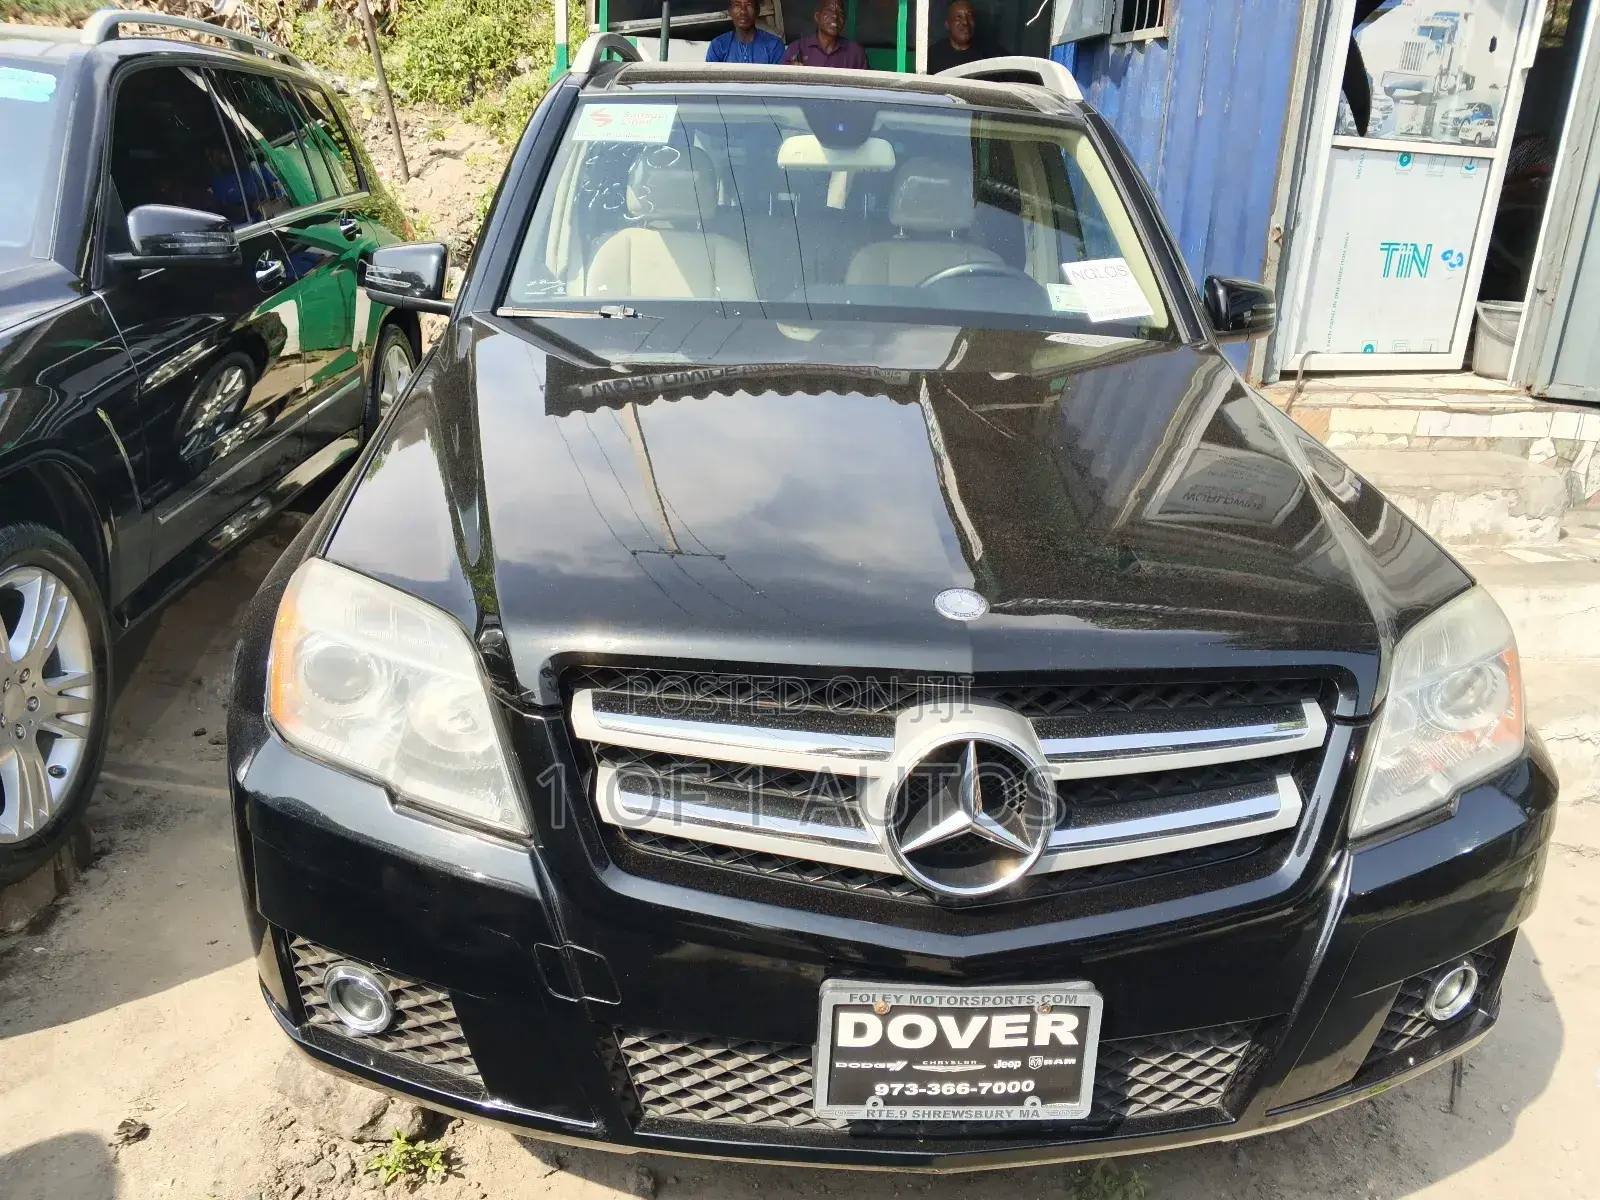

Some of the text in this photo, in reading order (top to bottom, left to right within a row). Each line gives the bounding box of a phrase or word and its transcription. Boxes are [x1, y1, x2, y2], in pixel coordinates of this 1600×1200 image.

[849, 993, 1079, 1006] FOLEY MOTORSPORTS.COM
[836, 1012, 1079, 1049] DOVER
[835, 1061, 896, 1070] DODGE
[993, 1058, 1022, 1070] Jeep
[1043, 1058, 1077, 1066] RAM
[874, 1079, 1036, 1097] 973-366-7000
[866, 1108, 1042, 1120] RTE.9 SHREWSBURY MA
